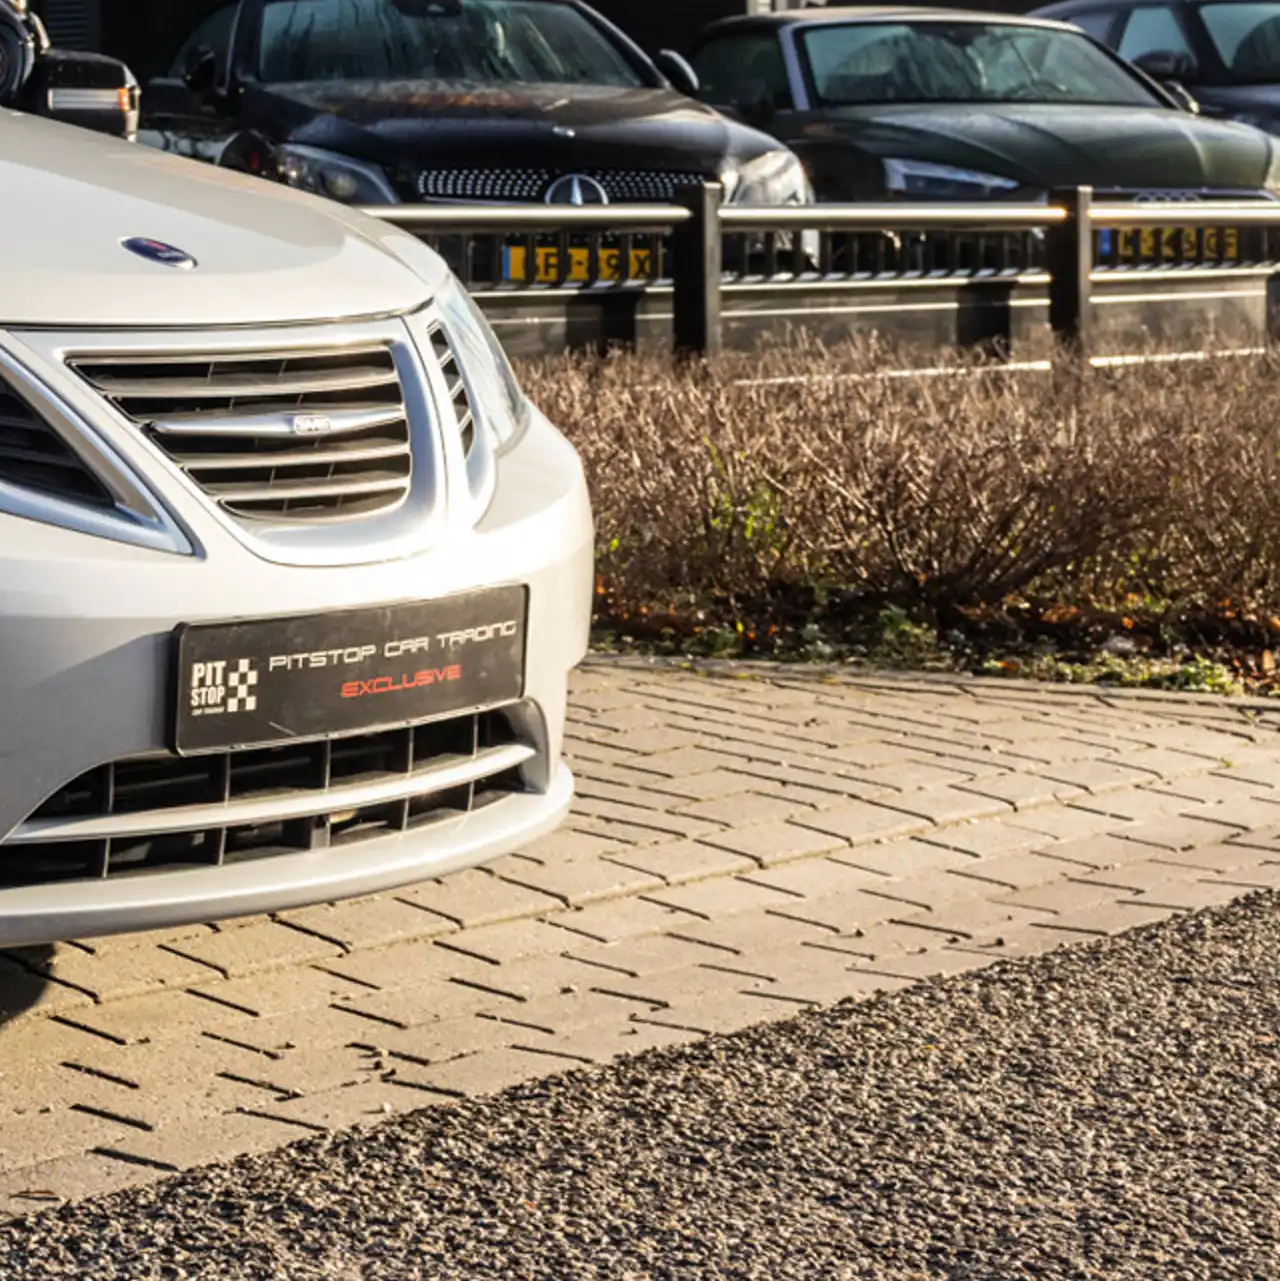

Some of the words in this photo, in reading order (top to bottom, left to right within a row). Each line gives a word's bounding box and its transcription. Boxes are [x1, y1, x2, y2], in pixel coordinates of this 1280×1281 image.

[268, 644, 376, 672] PITSTOP
[383, 635, 430, 658] CAR
[436, 620, 518, 647] TRADING
[191, 660, 227, 688] PIT
[340, 663, 462, 699] EXCLUSIVE
[190, 684, 226, 707] STOP
